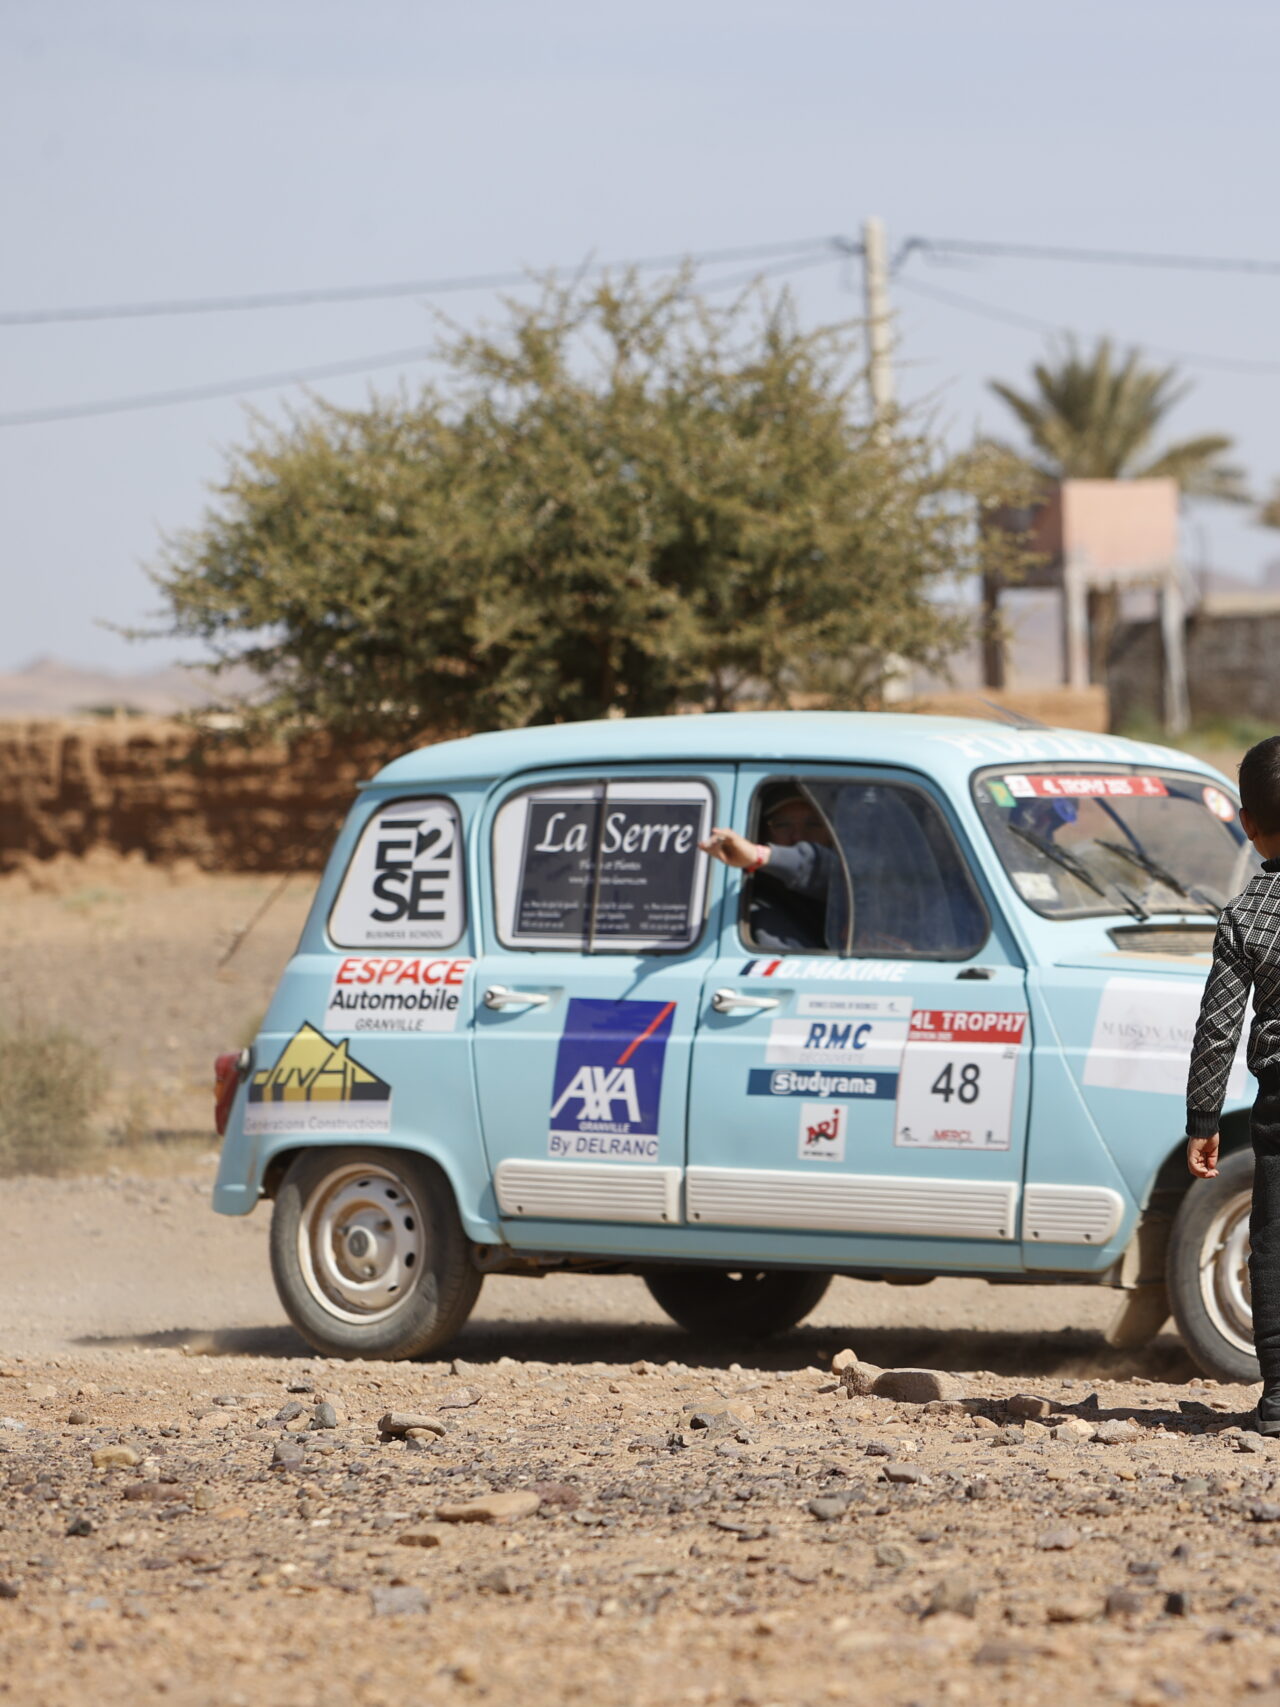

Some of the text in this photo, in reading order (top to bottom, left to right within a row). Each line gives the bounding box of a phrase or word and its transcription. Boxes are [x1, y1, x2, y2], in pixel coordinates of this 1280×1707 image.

[534, 811, 694, 854] La Serre
[335, 957, 473, 985] ESPACE
[329, 988, 459, 1011] Automobile
[354, 1018, 424, 1031] GRANVILLE
[911, 1011, 1027, 1033] 4L TROPHY
[1102, 1021, 1161, 1038] MAISON
[803, 1023, 873, 1050] RMC
[549, 1066, 642, 1123] AXA
[771, 1070, 877, 1098] Studyrama
[931, 1062, 981, 1105] 48
[551, 1135, 659, 1157] By DELRANC
